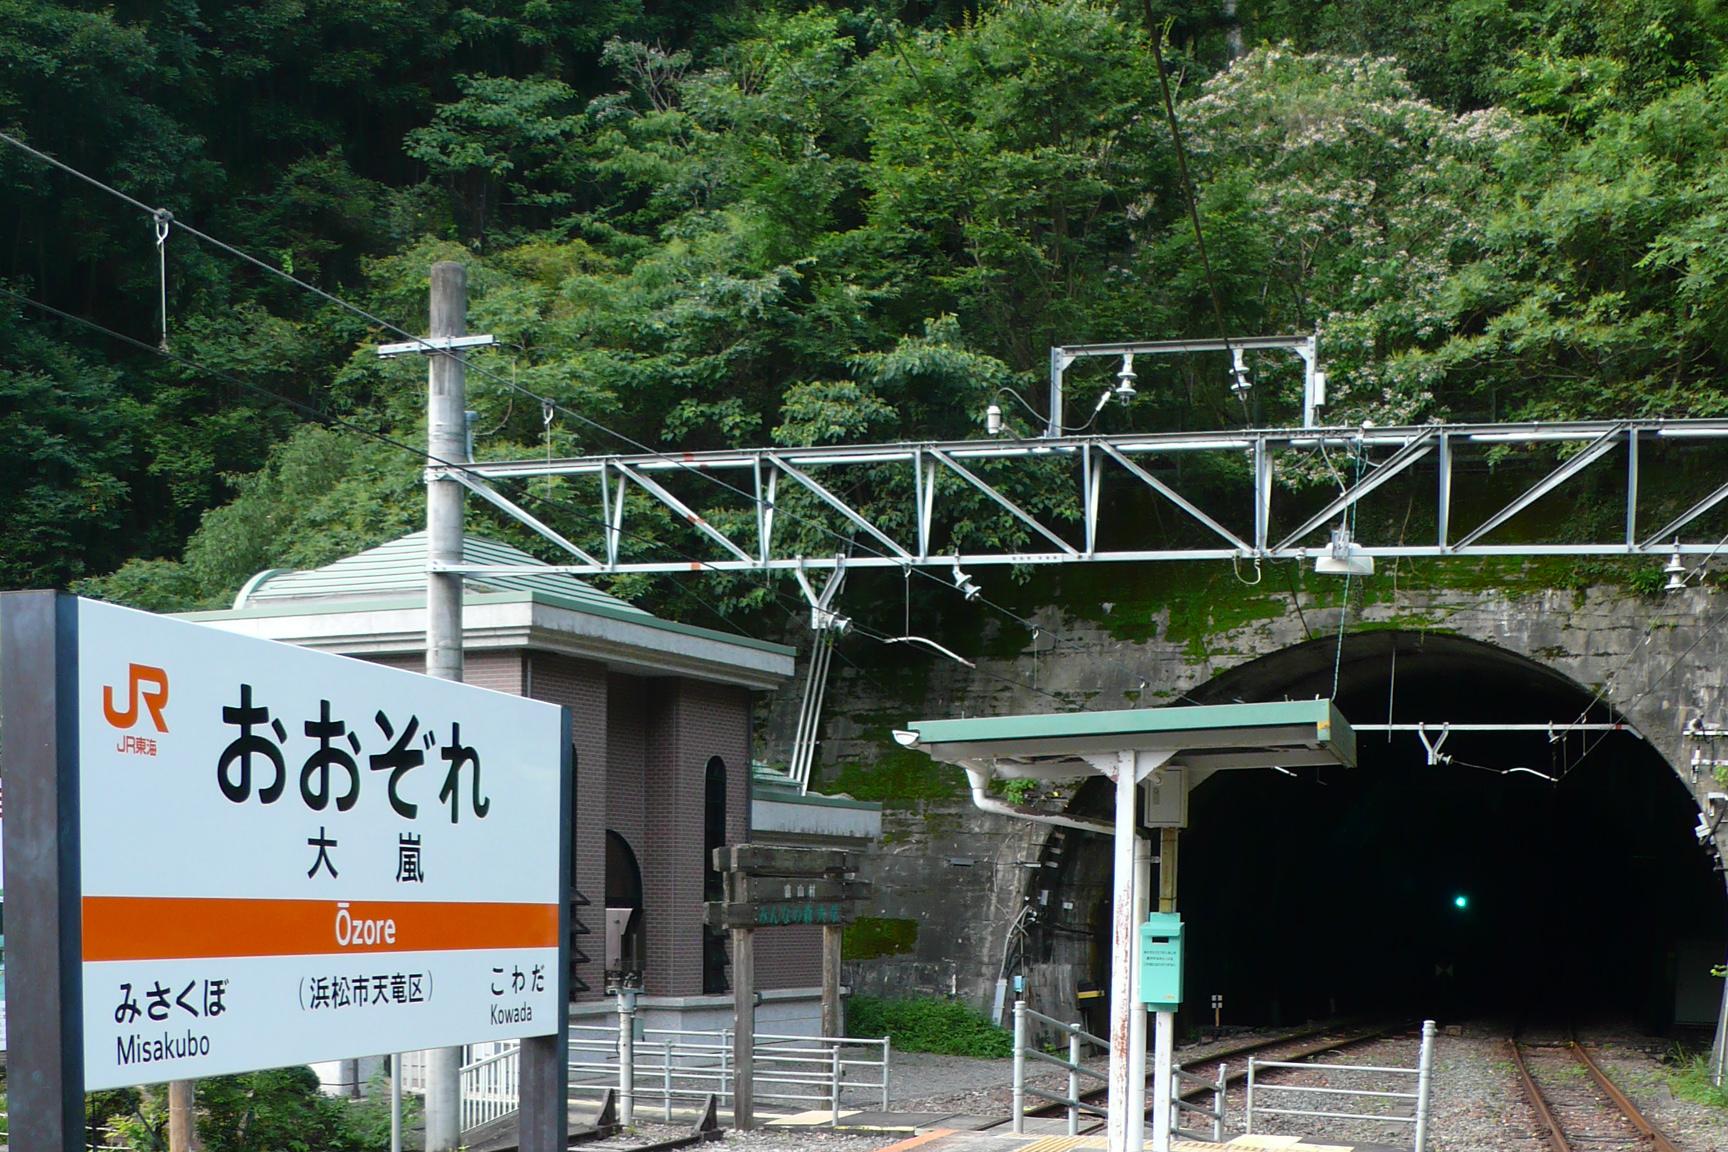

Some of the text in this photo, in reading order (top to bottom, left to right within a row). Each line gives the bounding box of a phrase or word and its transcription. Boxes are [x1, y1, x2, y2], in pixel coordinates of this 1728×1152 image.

[103, 663, 169, 733] JR
[116, 735, 158, 757] JR東海
[216, 684, 491, 824] おおぞれ
[335, 903, 396, 946] Ōzore
[490, 964, 545, 996] こわだ
[114, 979, 230, 1023] みさくぼ
[490, 1001, 533, 1025] Kowada
[117, 1029, 210, 1066] Misakubo
